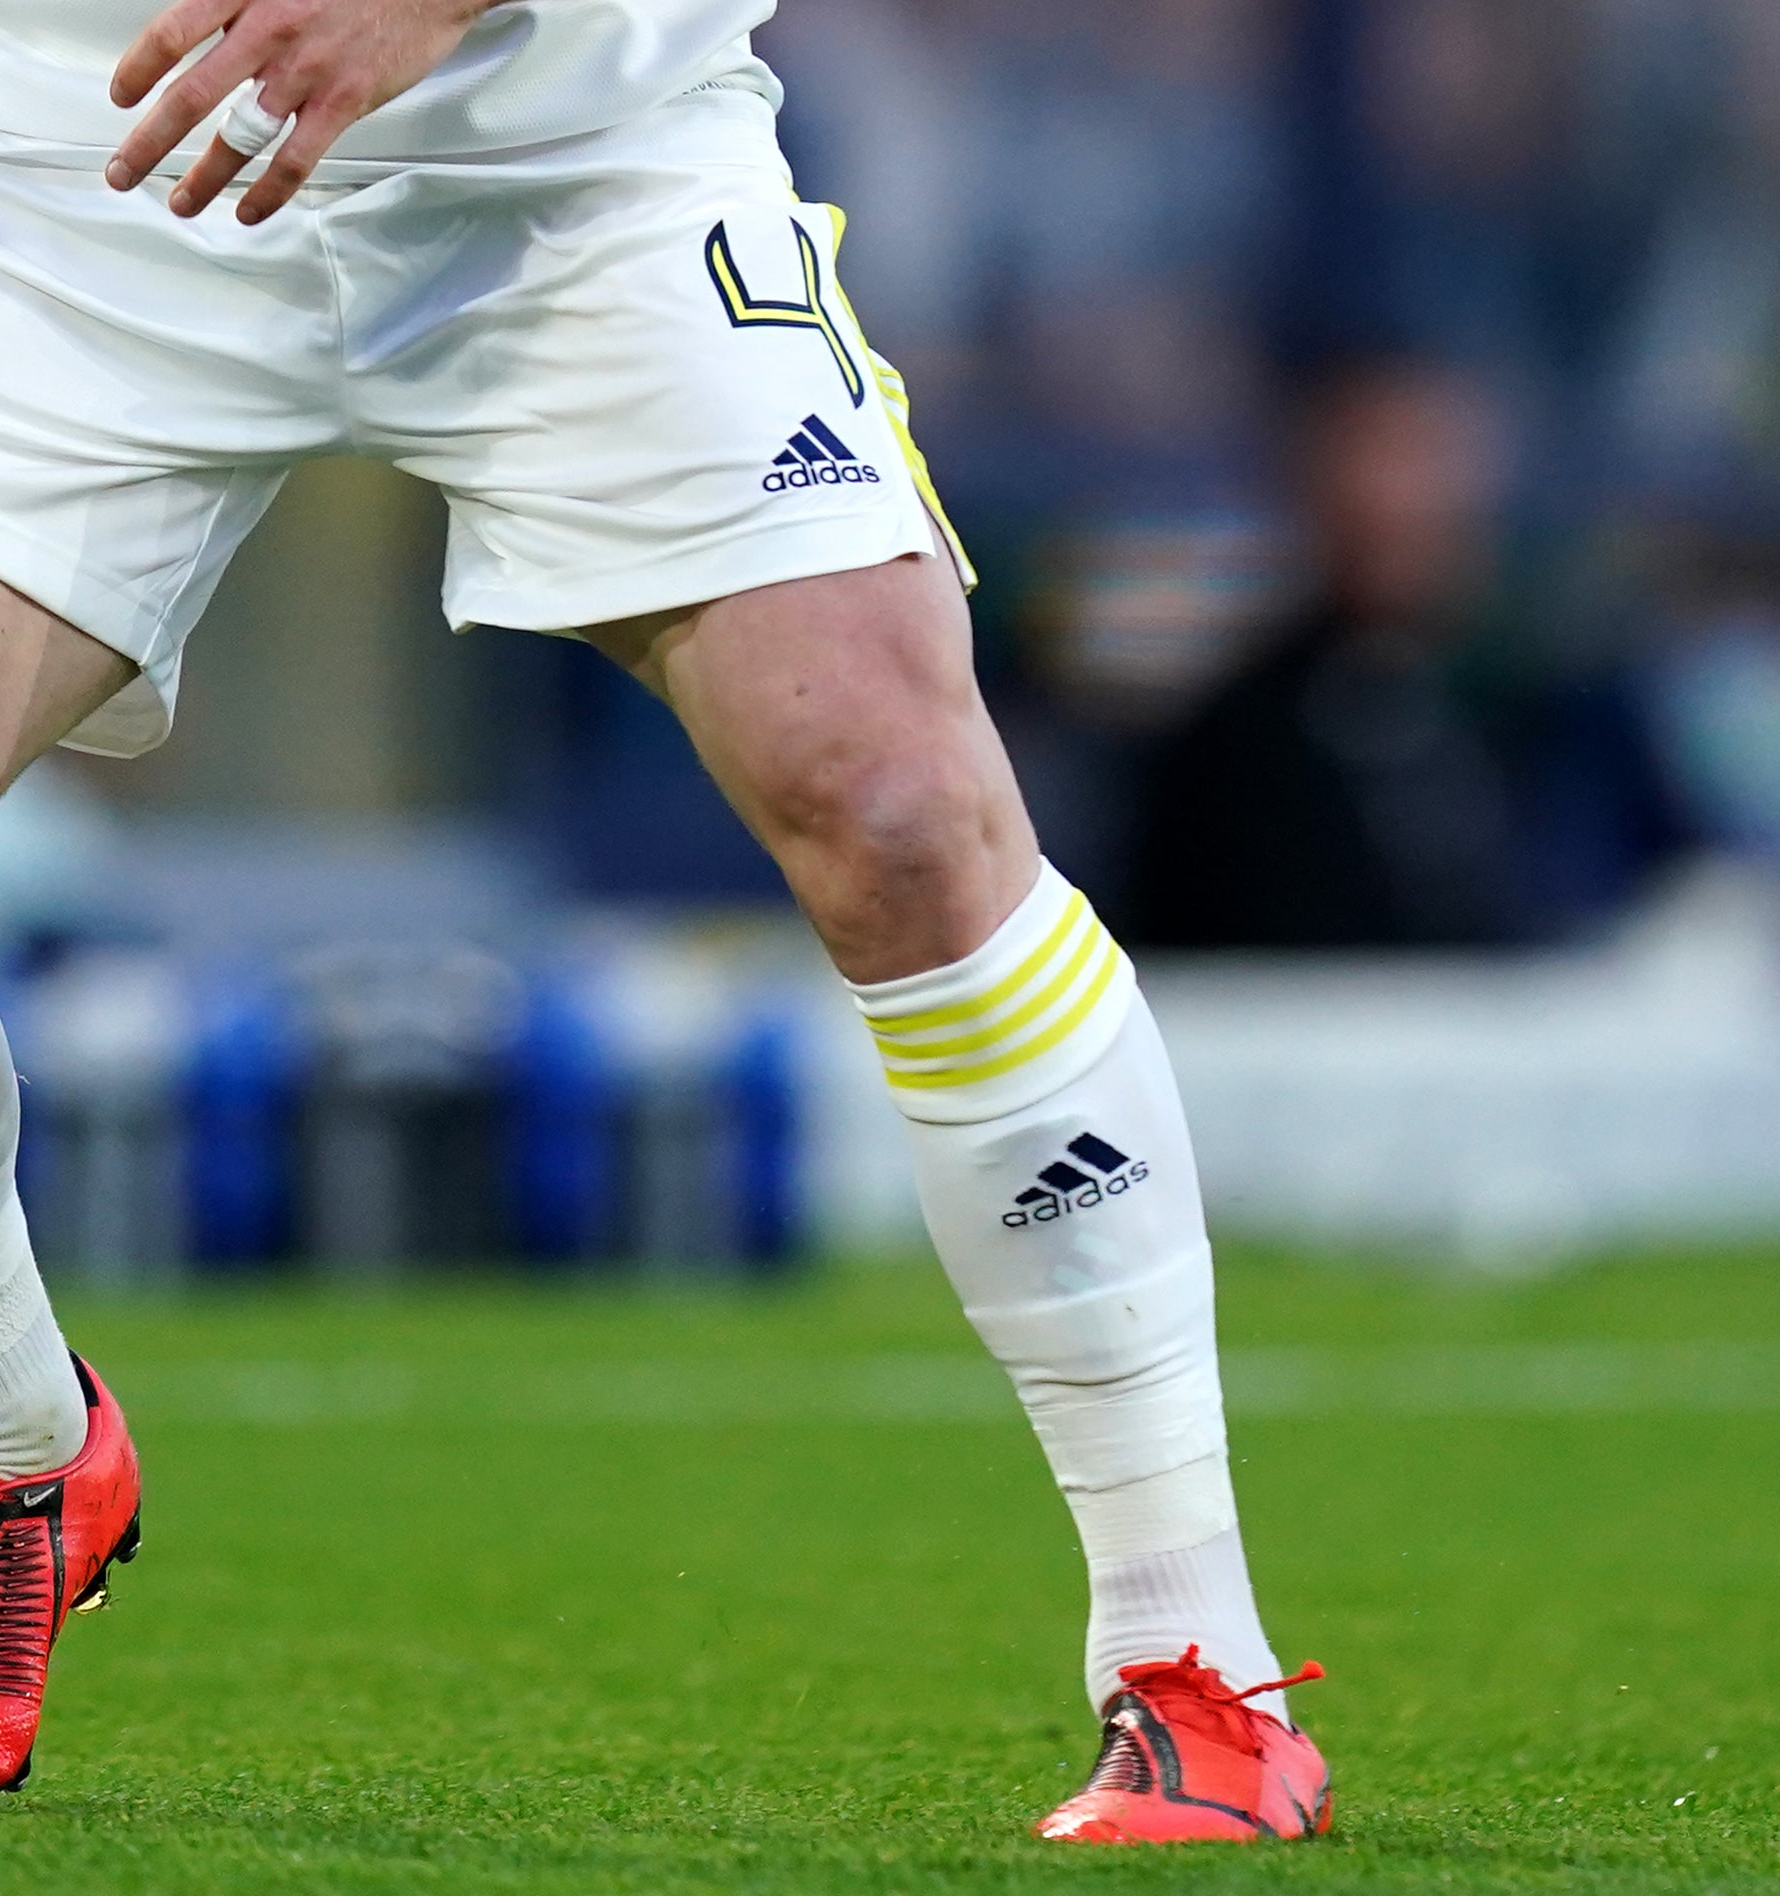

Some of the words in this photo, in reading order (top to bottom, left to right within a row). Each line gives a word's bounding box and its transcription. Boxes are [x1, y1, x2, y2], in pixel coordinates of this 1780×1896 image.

[704, 216, 865, 410] 4
[761, 458, 881, 493] adidas
[1001, 1160, 1151, 1229] adidas
